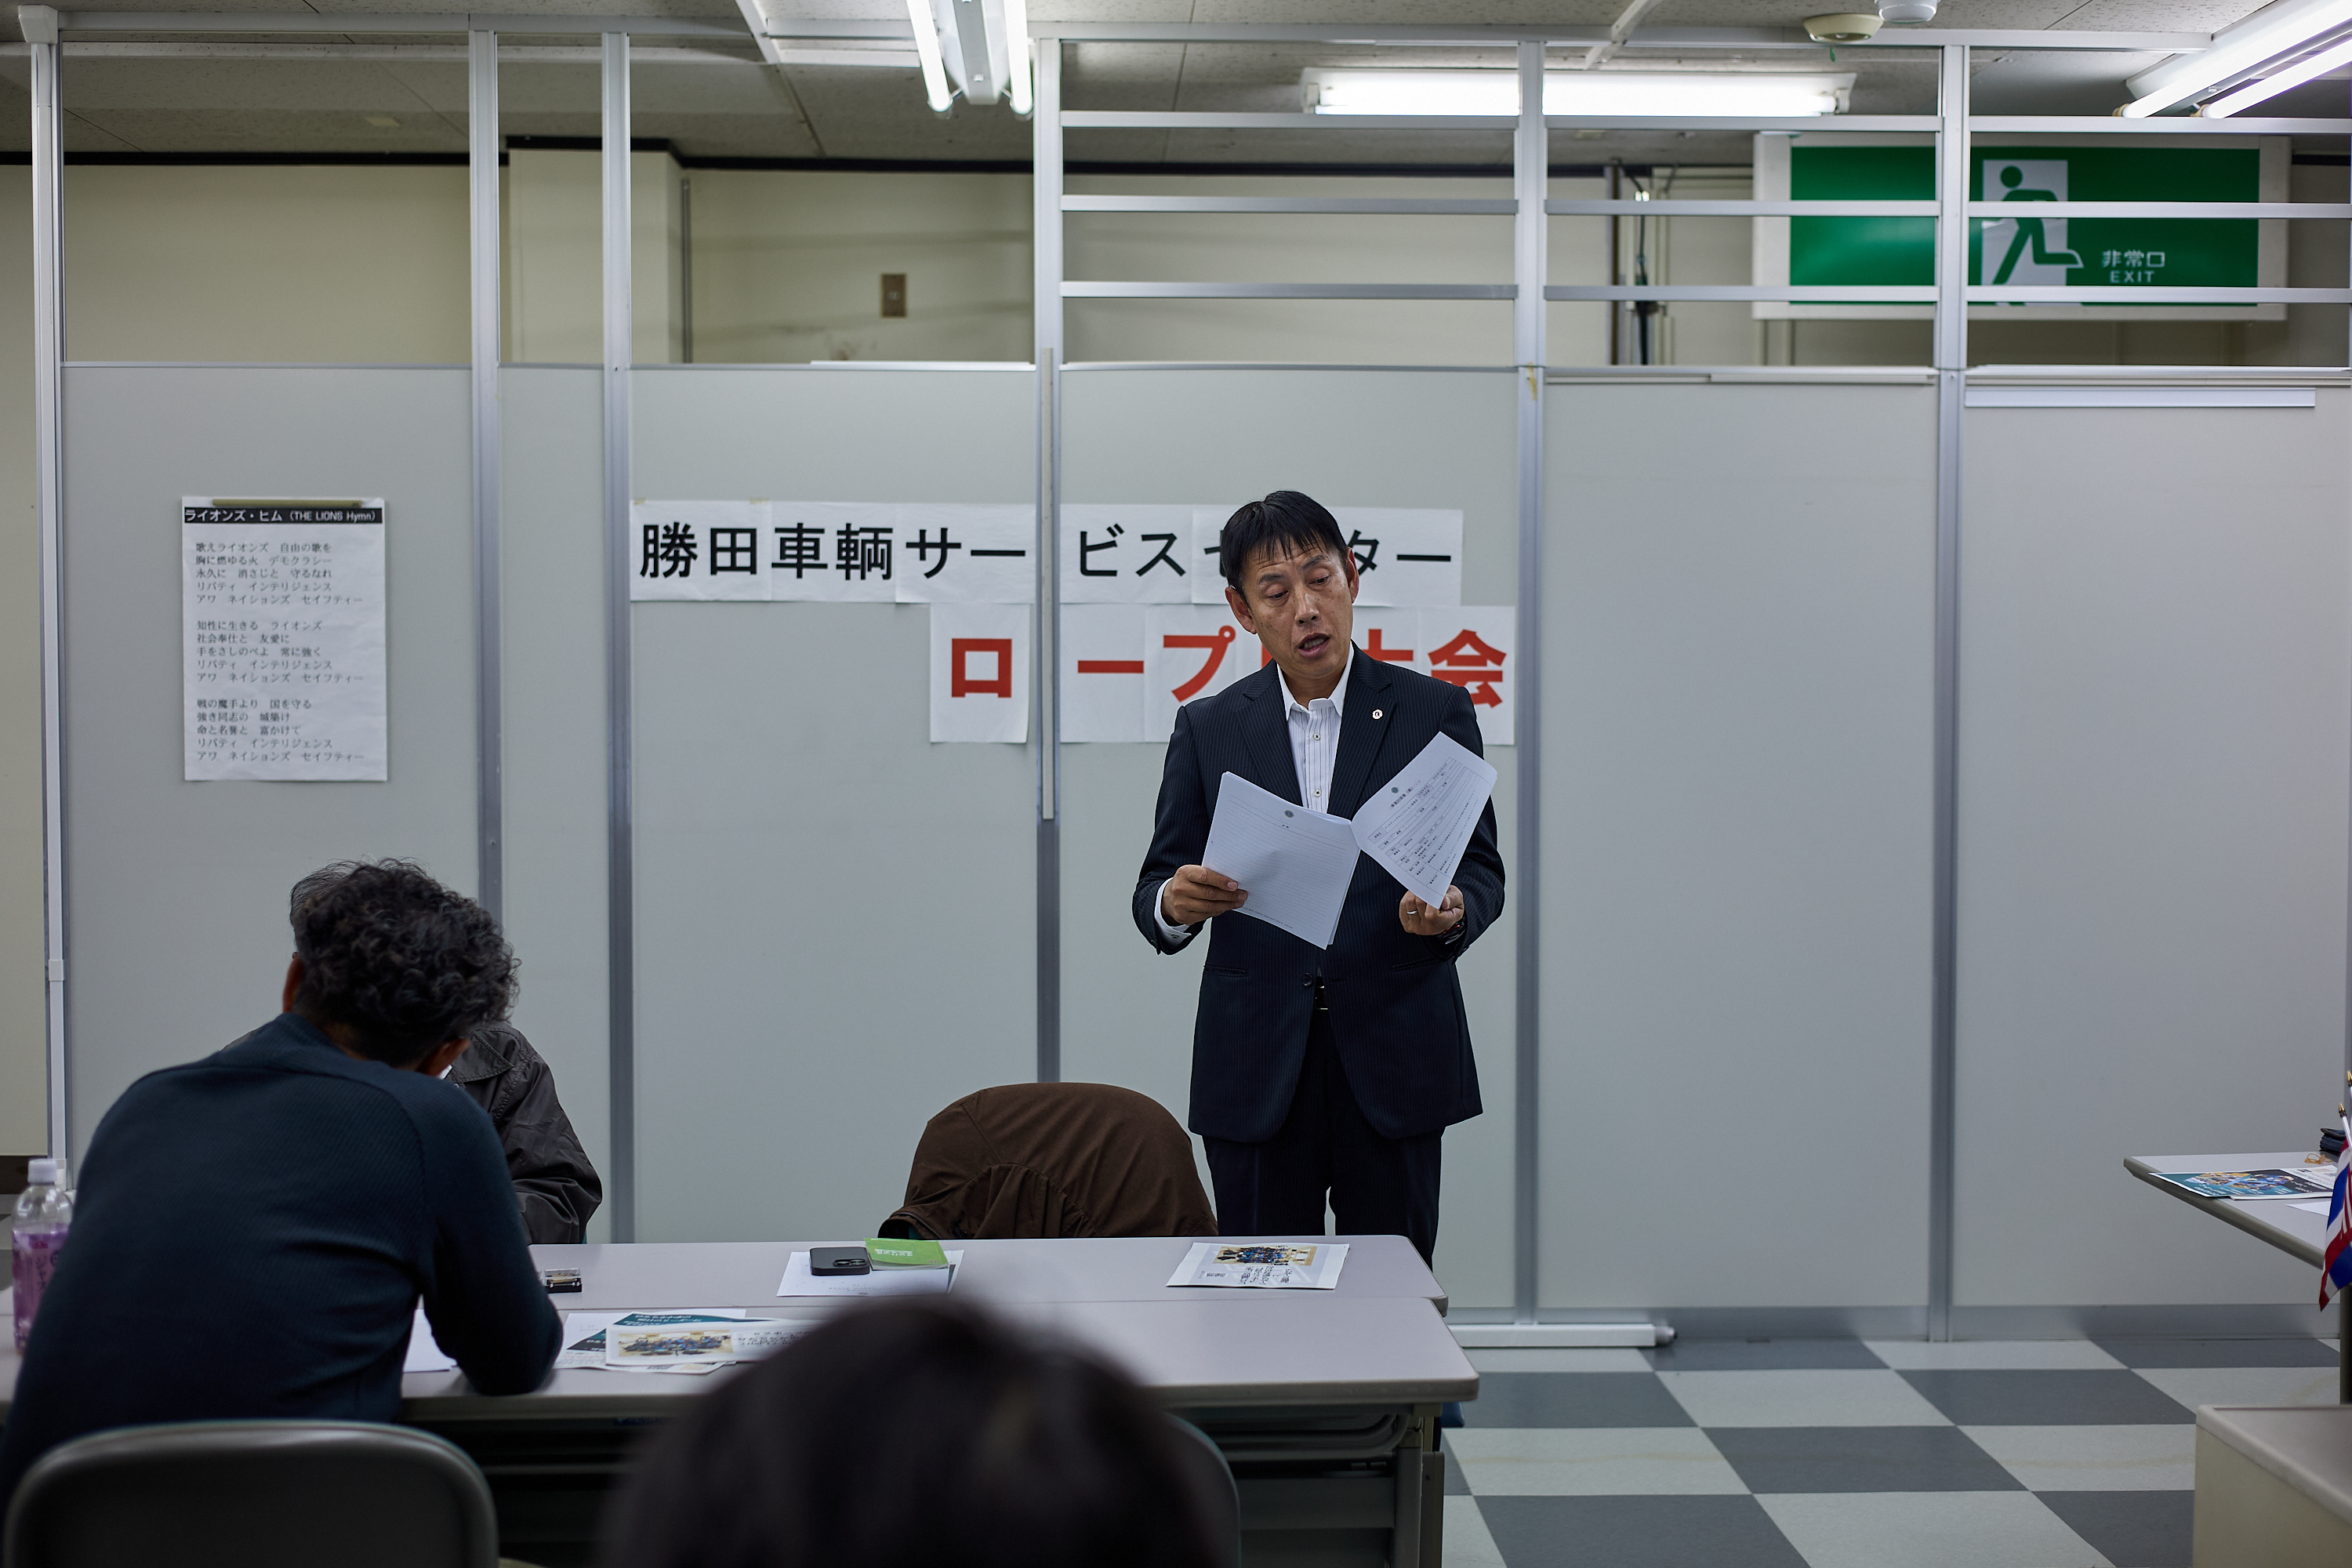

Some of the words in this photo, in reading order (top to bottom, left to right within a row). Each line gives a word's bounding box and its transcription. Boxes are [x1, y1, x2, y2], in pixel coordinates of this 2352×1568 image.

[2102, 249, 2165, 267] 非常口
[2110, 270, 2155, 283] EXIT
[185, 511, 282, 522] ライオンズ・ヒム
[316, 511, 343, 521] LIONS
[280, 543, 332, 553] 自由の歌を
[640, 521, 1451, 582] 勝田車輌サービスター
[269, 556, 332, 565] デモクラシー
[195, 568, 227, 579] 永久に
[290, 568, 332, 579] 守るなれ
[249, 582, 332, 591] インテリジェンス
[227, 594, 291, 604] ネイションズ
[197, 620, 259, 631] 知性に生きる
[270, 620, 323, 631] ライオンズ
[197, 633, 248, 644] 社会奉仕と
[260, 633, 290, 644] 友愛に
[280, 647, 321, 657] 常に強く
[249, 660, 333, 670] インテリジェンス
[951, 625, 1507, 708] ロープ会
[229, 673, 291, 683] ネイションズ
[269, 699, 312, 710] 国を守る
[197, 713, 249, 722] 強き同志の
[250, 739, 333, 748] インテリジェンス
[229, 751, 292, 761] ネイションズ
